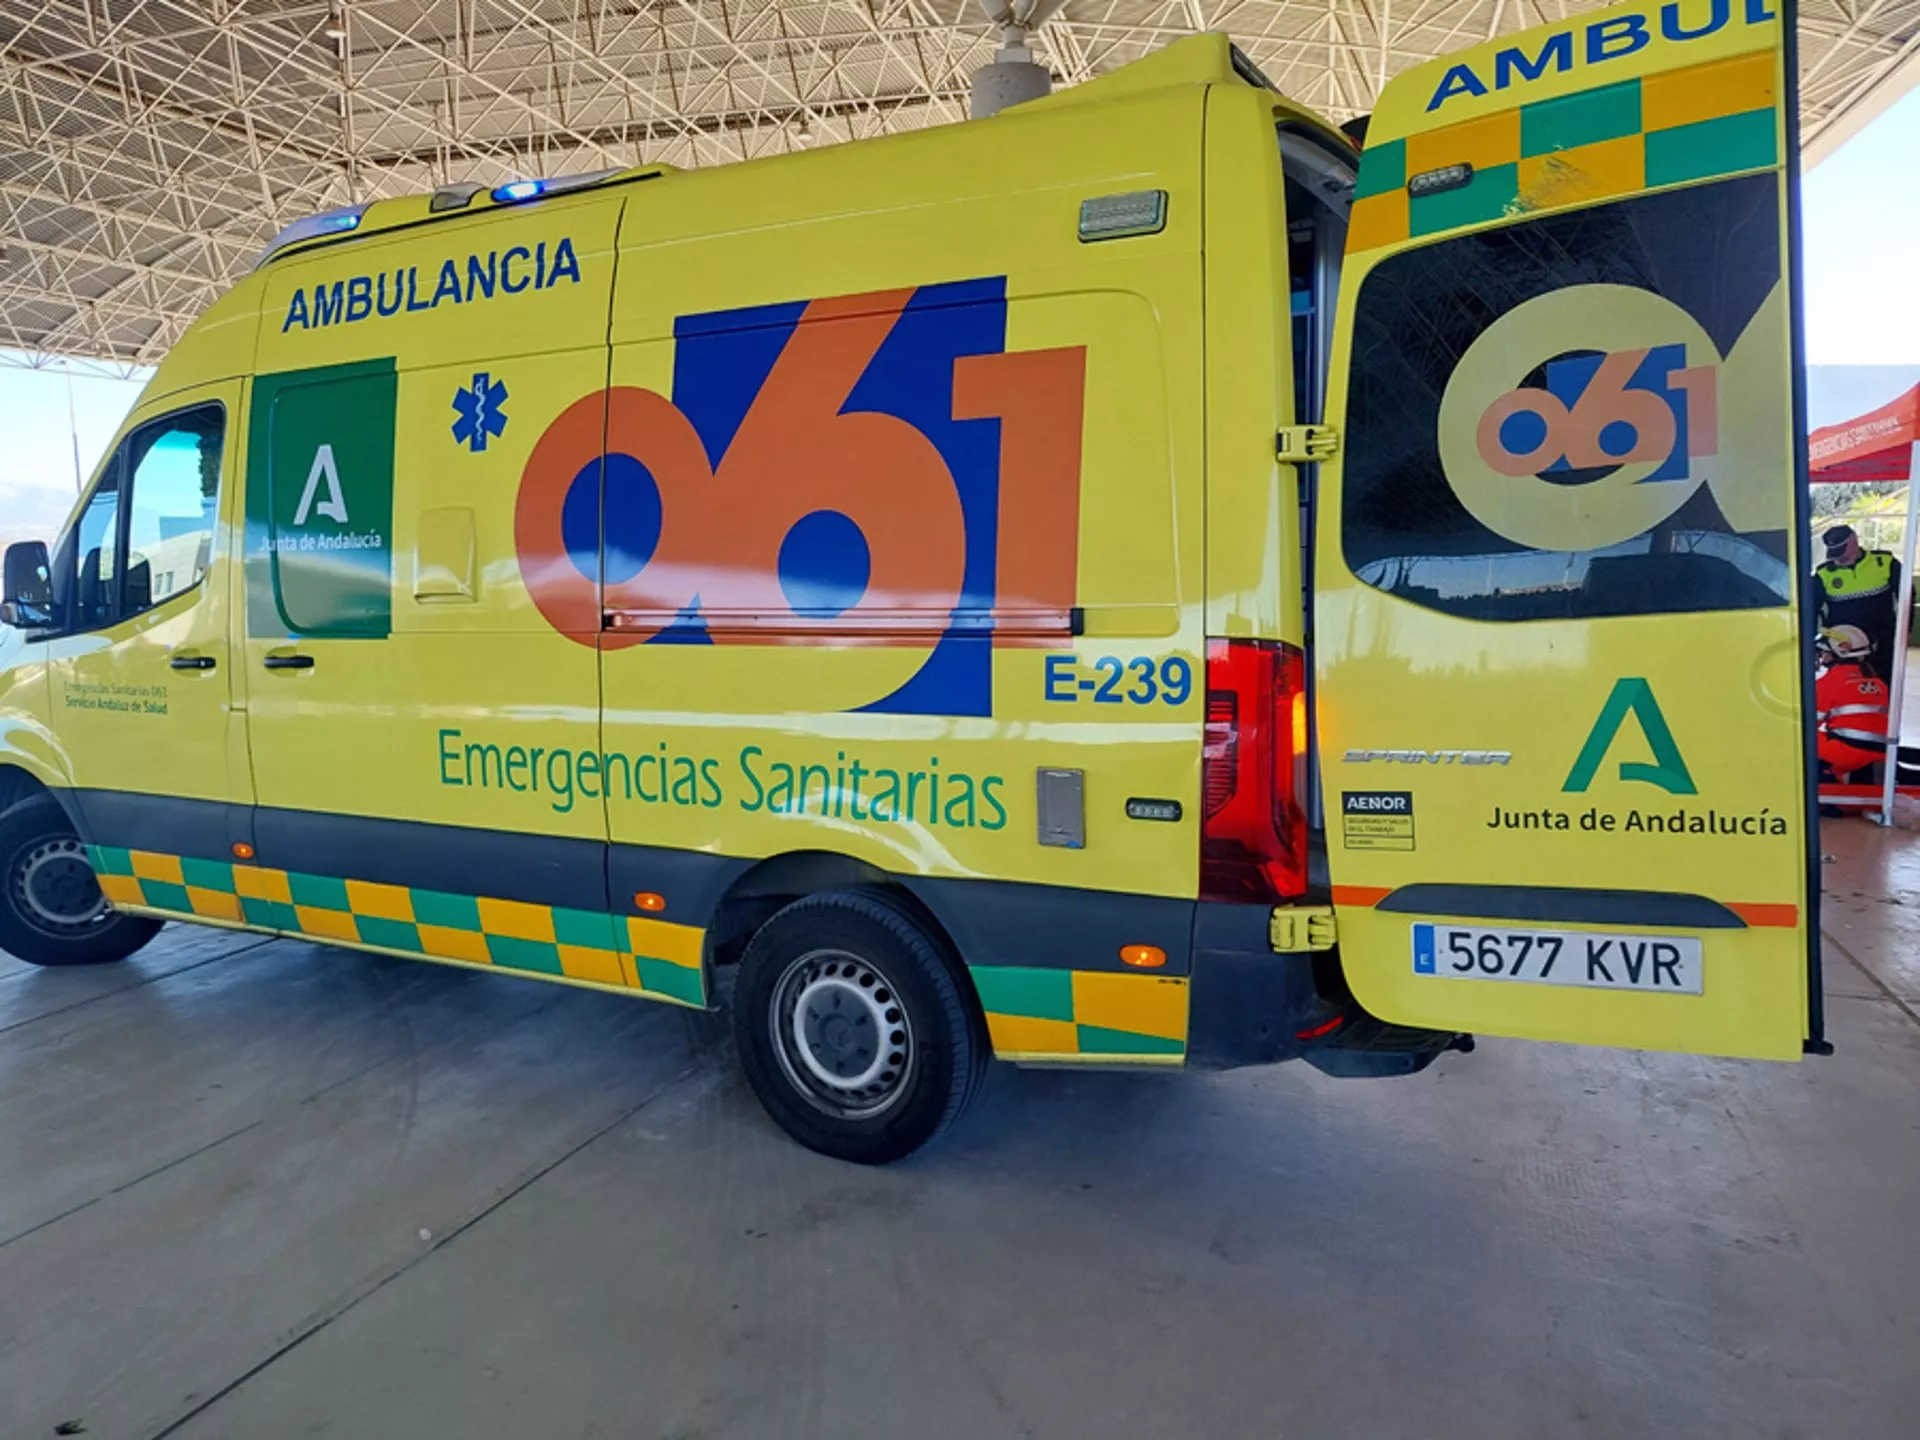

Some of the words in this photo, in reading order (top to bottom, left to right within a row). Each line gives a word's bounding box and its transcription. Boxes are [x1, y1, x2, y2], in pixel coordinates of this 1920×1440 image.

[1426, 0, 1776, 112] AMBUL
[281, 237, 581, 334] AMBULANCIA
[1476, 347, 1718, 478] 061
[513, 286, 1088, 652] 061
[259, 535, 298, 552] Junta
[299, 533, 316, 551] de
[317, 529, 382, 550] Andalucía
[1044, 655, 1193, 705] E-239
[438, 729, 722, 813] Emergencias
[739, 745, 1008, 831] Sanitarias
[1342, 749, 1512, 767] SPRINTER
[1347, 796, 1406, 810] AENOR
[1487, 807, 1570, 831] Junta
[1580, 808, 1617, 832] de
[1625, 808, 1788, 836] Andalucía
[1420, 953, 1431, 965] E
[1448, 931, 1564, 978] 5677
[1586, 938, 1683, 987] KVR
